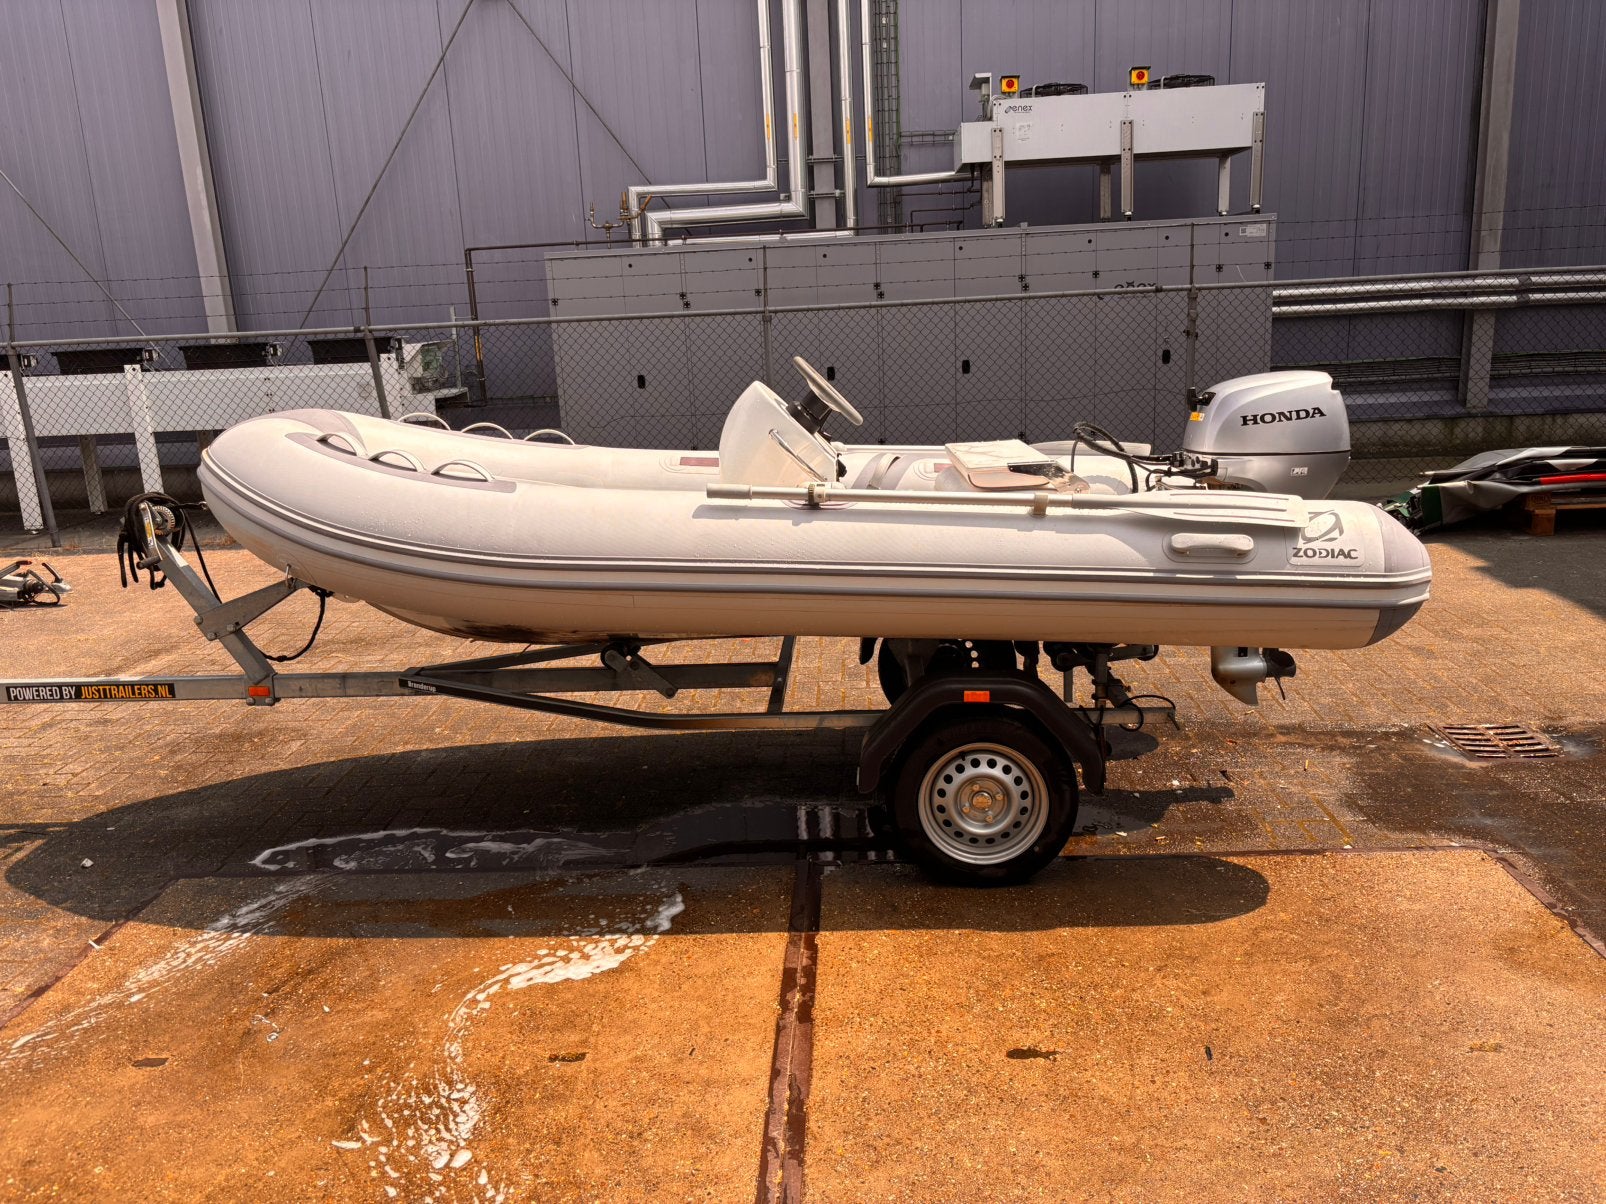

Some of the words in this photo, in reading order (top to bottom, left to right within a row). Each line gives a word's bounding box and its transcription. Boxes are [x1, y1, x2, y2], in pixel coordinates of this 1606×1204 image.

[1240, 407, 1327, 427] HONDA
[1292, 547, 1359, 560] ZODIAC
[9, 686, 61, 701] POWERED
[61, 686, 76, 700] BY
[81, 685, 173, 699] JUSTTRAILERS.NL
